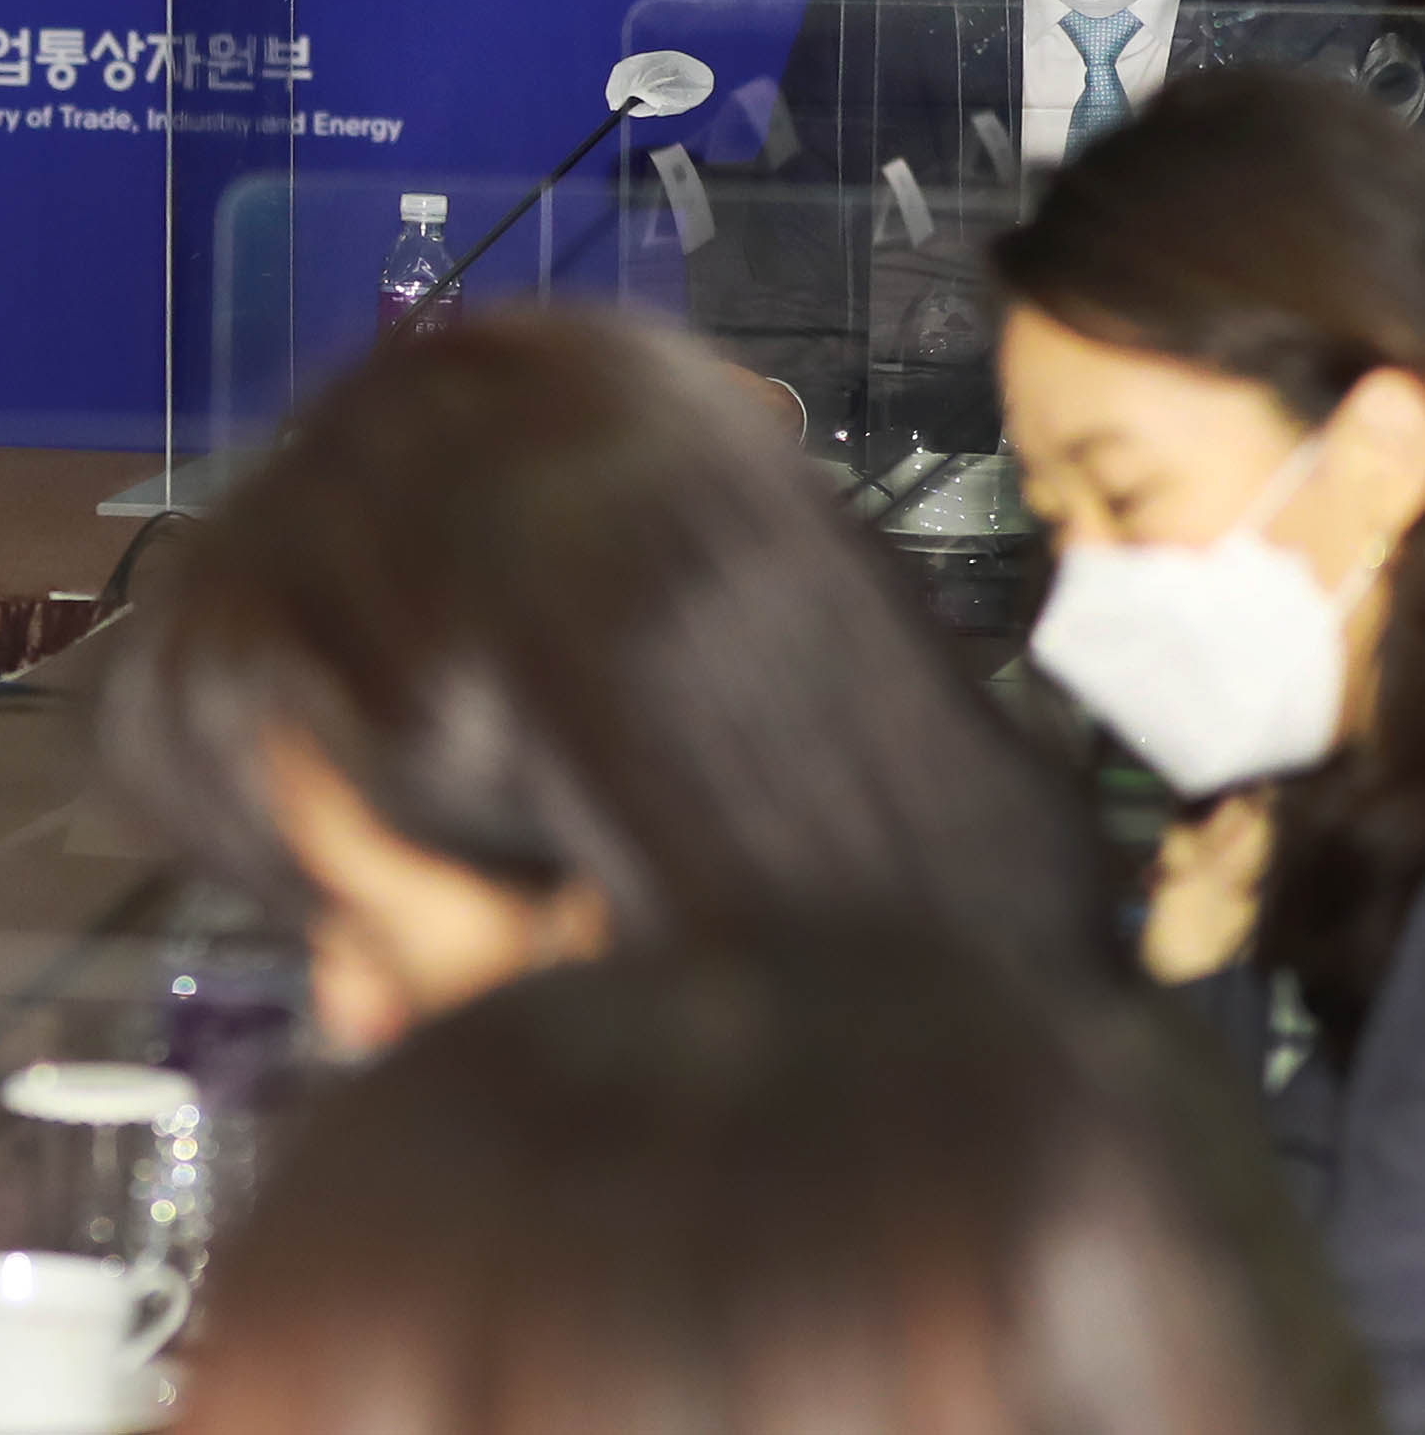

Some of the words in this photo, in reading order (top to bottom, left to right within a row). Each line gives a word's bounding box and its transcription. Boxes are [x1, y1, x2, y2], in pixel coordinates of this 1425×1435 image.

[24, 105, 53, 129] of
[59, 104, 140, 135] Trade,
[312, 112, 404, 144] Energy
